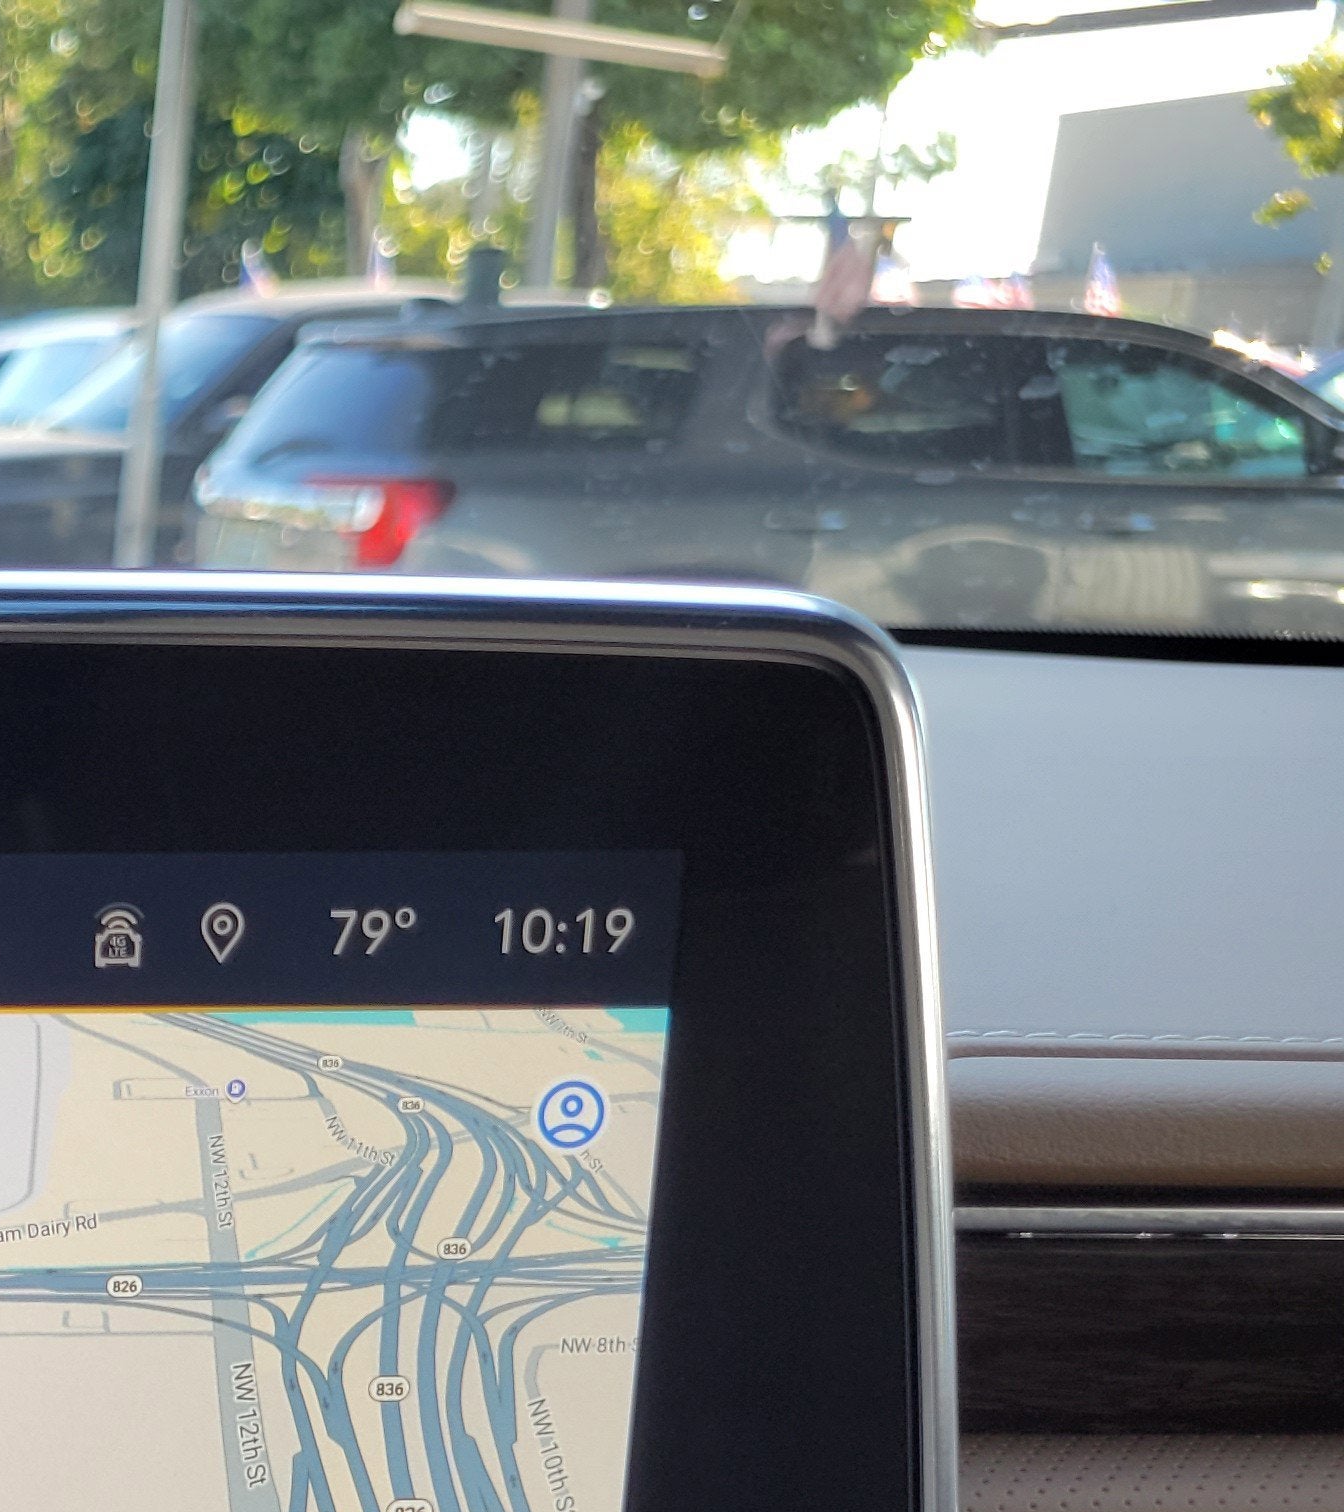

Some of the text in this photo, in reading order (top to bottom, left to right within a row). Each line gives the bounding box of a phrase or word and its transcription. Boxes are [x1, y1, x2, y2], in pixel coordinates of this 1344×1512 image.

[329, 907, 418, 956] 79°
[492, 907, 637, 956] 10:19
[325, 1115, 345, 1141] NW
[379, 1150, 396, 1167] St
[209, 1135, 233, 1229] NW 12th St
[27, 1217, 71, 1239] Dairy
[75, 1214, 98, 1231] Rd
[443, 1243, 467, 1255] 836
[112, 1280, 138, 1294] 826
[561, 1337, 592, 1353] NW
[597, 1337, 626, 1353] 8th
[376, 1383, 404, 1396] 836
[233, 1363, 266, 1488] NW 12th St
[527, 1398, 554, 1436] NW
[541, 1443, 568, 1492] 10th
